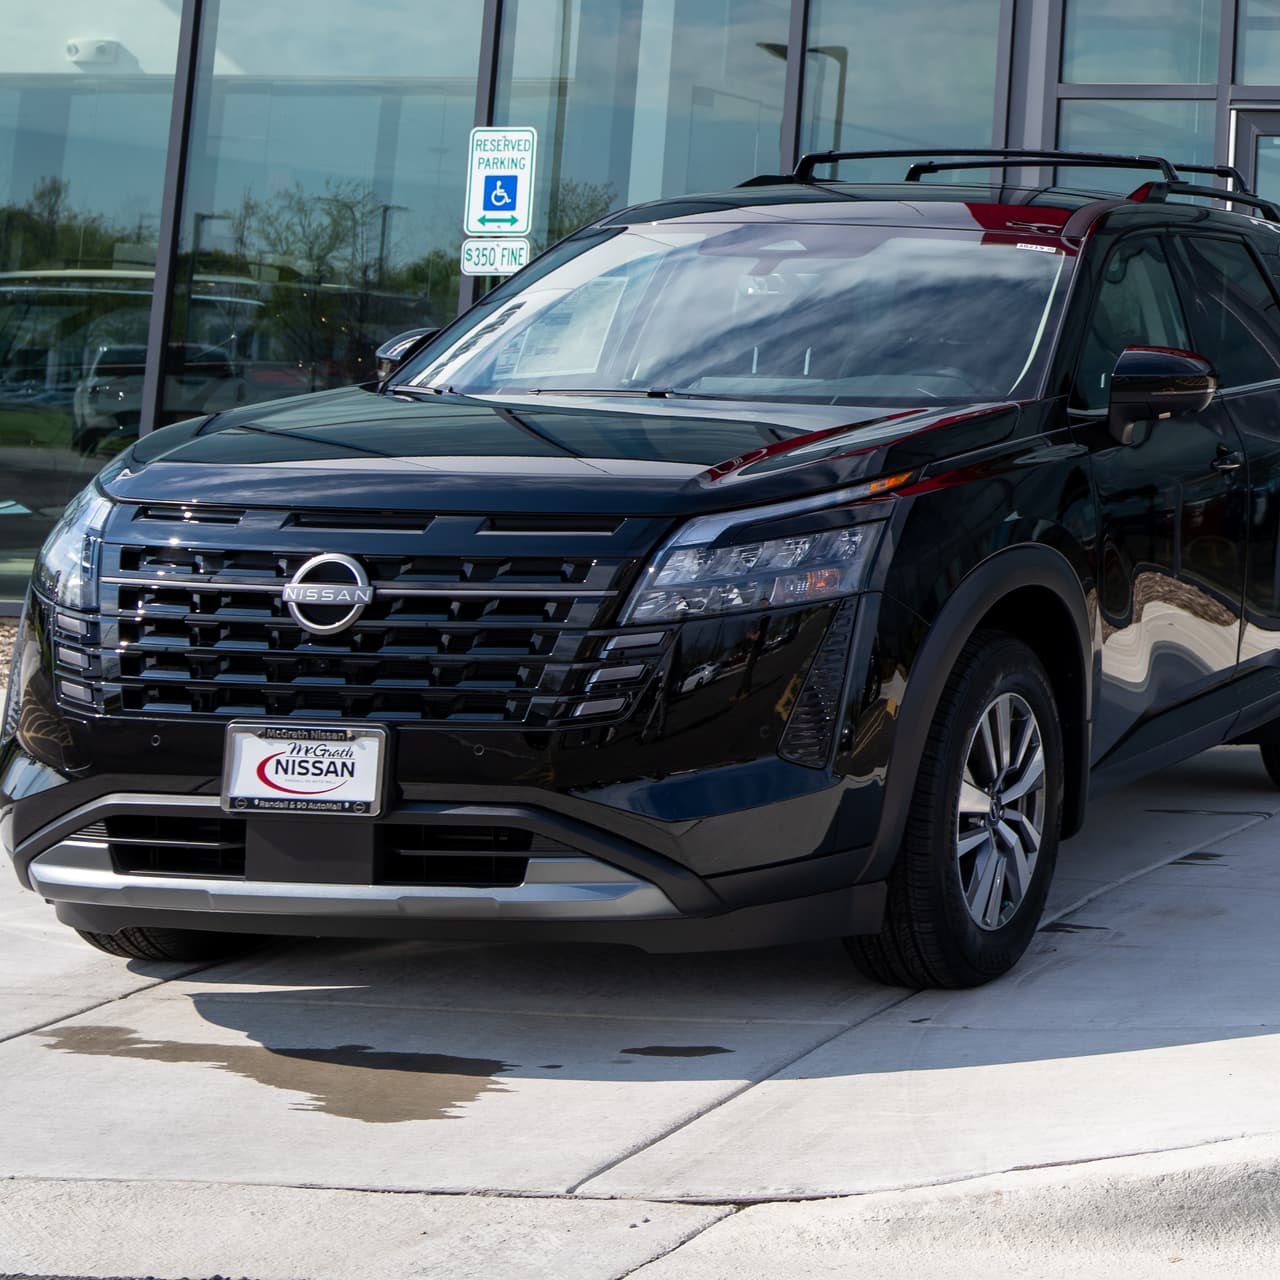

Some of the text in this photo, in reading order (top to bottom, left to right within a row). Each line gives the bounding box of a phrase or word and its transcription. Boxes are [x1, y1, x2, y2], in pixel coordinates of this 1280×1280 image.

[475, 138, 531, 153] RESERVED
[477, 157, 526, 170] PARKING
[465, 247, 525, 266] $350 FINE
[284, 587, 370, 602] NISSAN
[266, 728, 346, 741] McGrath Nissan
[287, 742, 354, 759] McGrath
[274, 758, 356, 778] NISSAN
